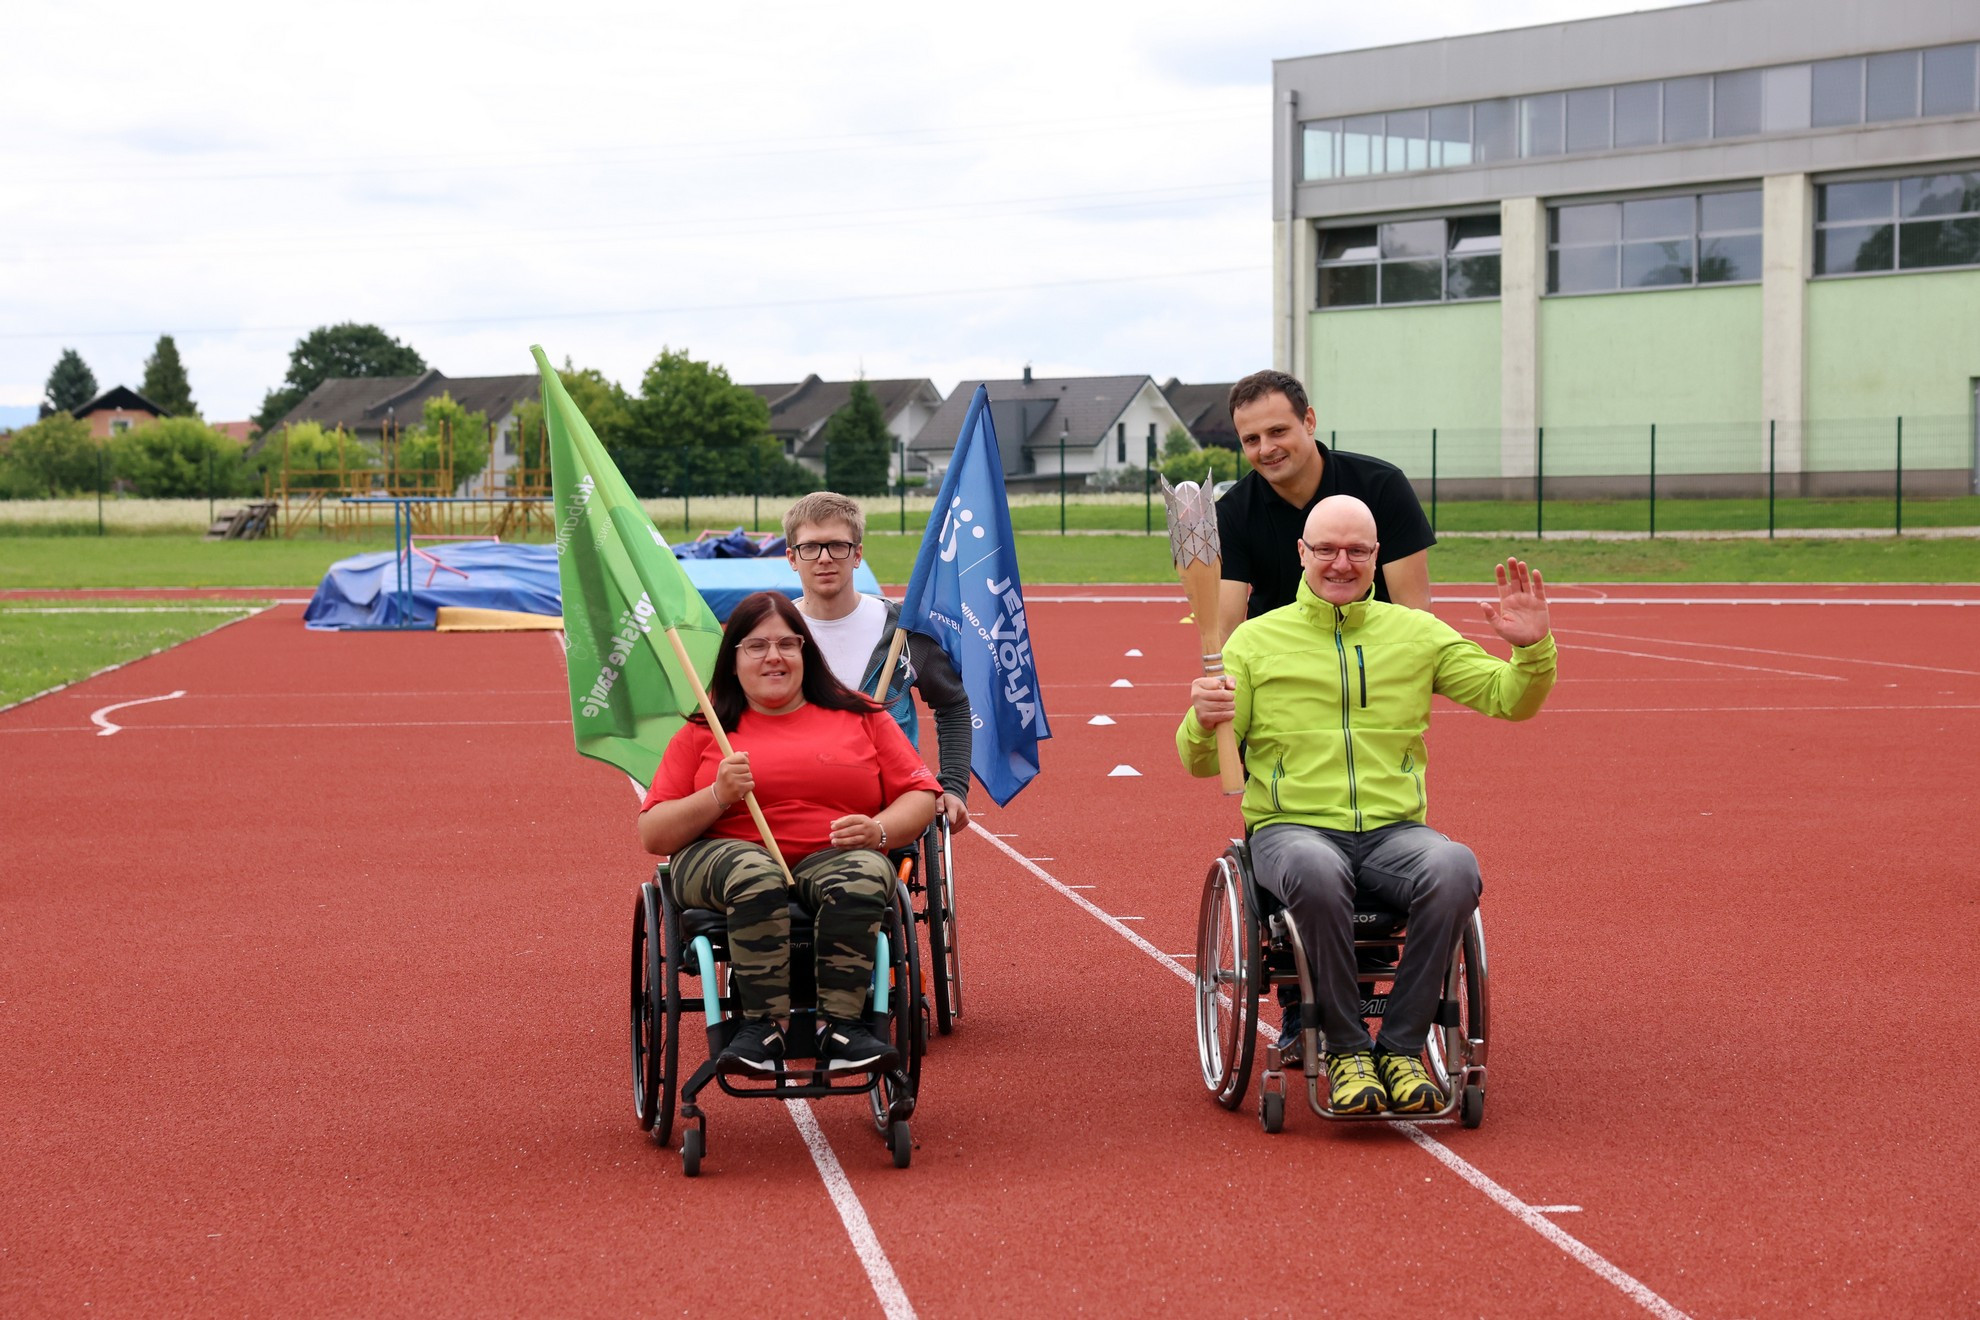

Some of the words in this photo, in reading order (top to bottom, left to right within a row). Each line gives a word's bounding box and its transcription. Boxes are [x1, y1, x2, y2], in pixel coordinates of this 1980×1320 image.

[960, 602, 980, 627] MIND
[978, 627, 991, 642] OF
[987, 642, 1002, 676] STEEL
[987, 576, 1032, 670] JEKL
[990, 612, 1035, 730] VOLJA
